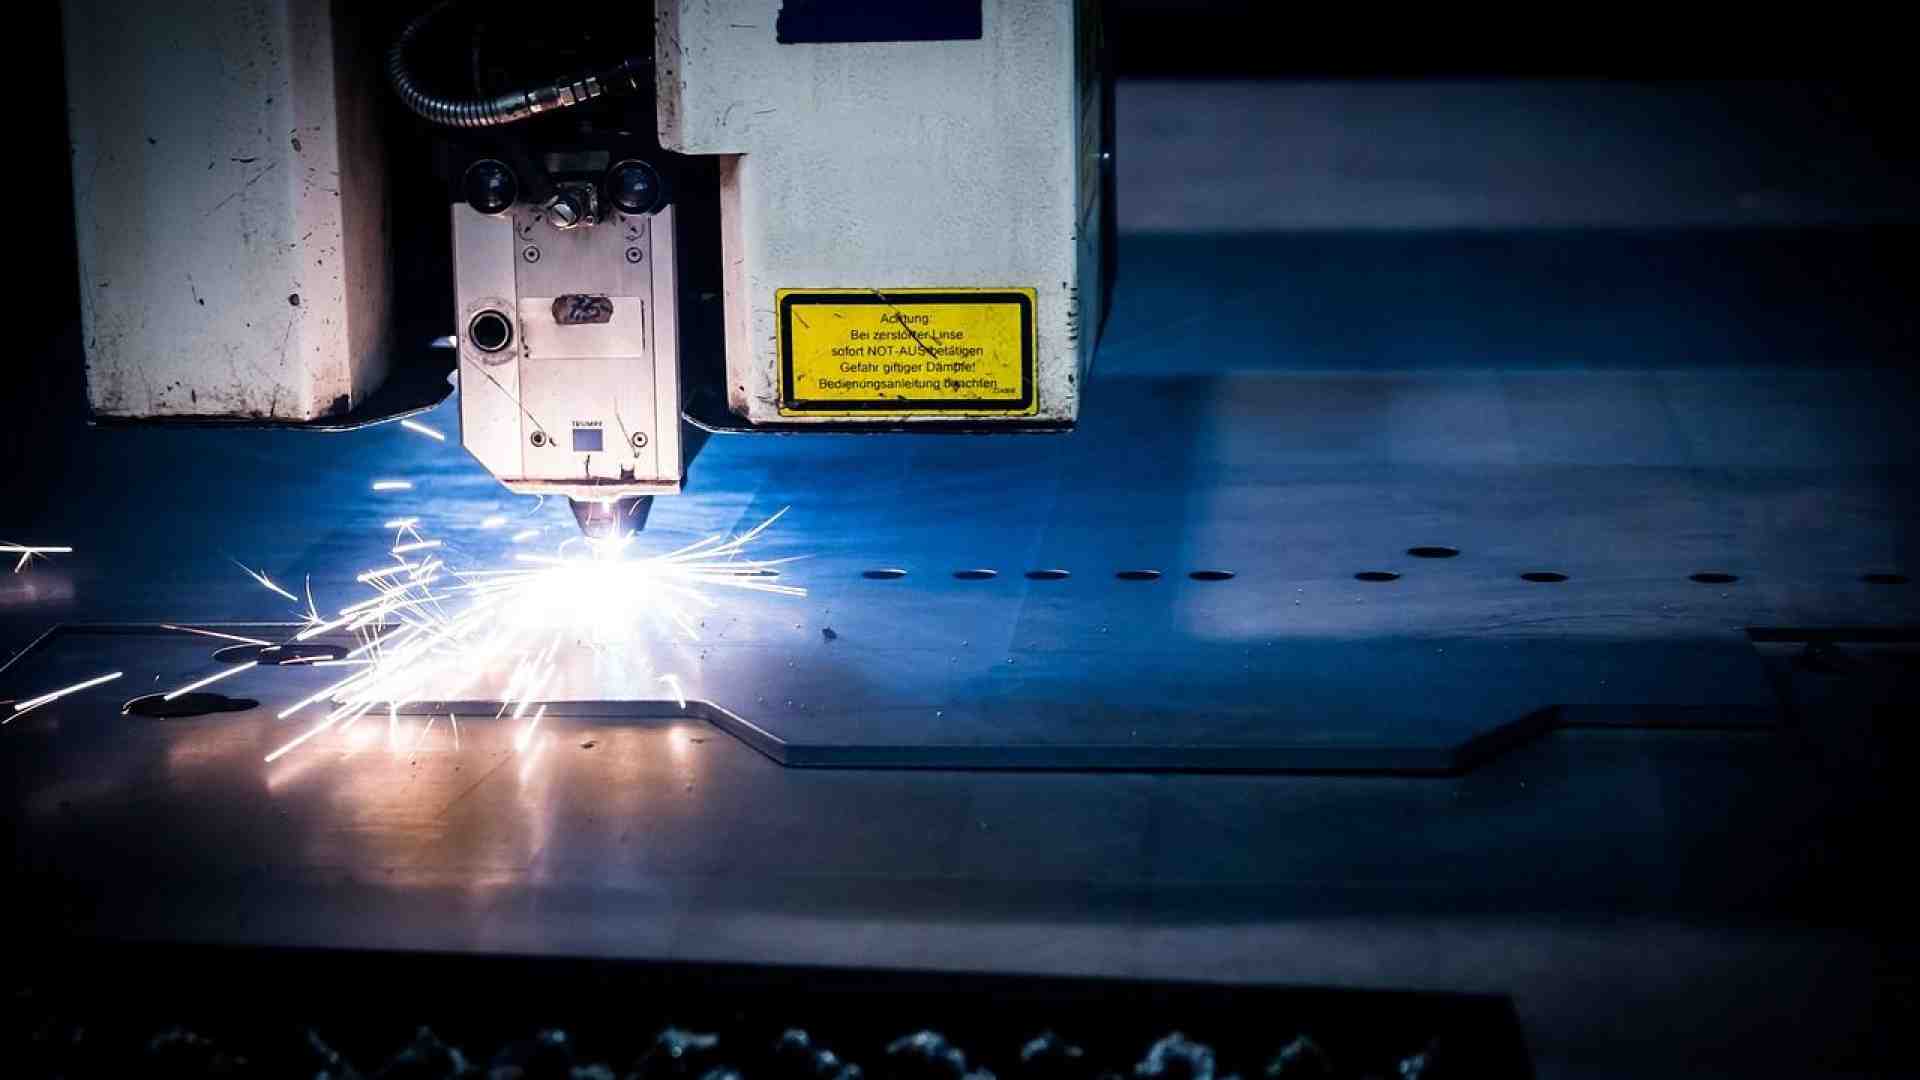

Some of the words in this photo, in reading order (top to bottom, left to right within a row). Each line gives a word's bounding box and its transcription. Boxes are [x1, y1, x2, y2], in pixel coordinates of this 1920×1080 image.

[851, 329, 869, 340] Bei
[932, 329, 963, 340] Linse
[831, 345, 864, 357] sofort
[867, 345, 926, 357] NOT-AUS
[840, 362, 879, 373] Gefahr
[882, 362, 922, 375] giftiger
[818, 378, 941, 391] Bedienungsanleitung
[944, 378, 998, 390] bachten
